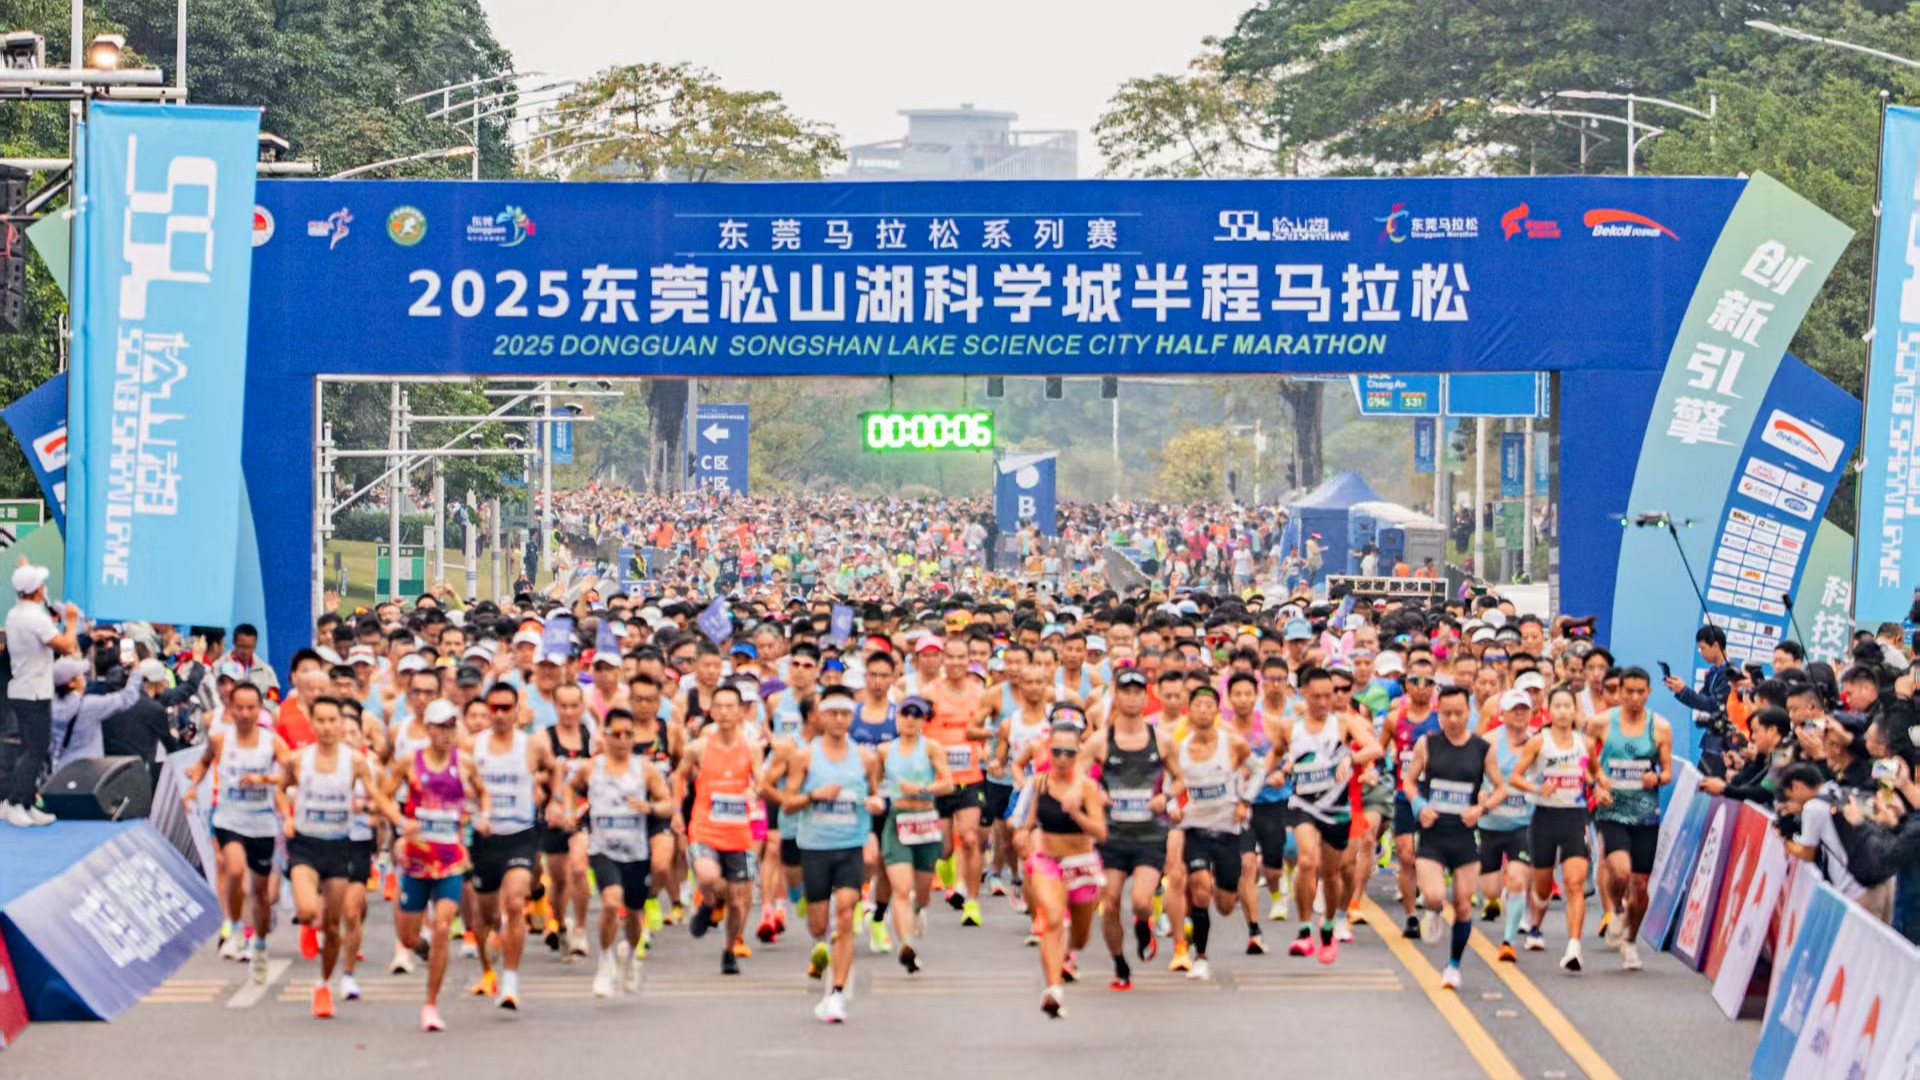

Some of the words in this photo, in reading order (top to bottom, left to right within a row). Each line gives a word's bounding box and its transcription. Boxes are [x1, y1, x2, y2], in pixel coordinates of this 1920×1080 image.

[719, 217, 1118, 250] 东莞马拉松系列赛
[1411, 217, 1478, 232] 东莞马拉松
[408, 262, 1471, 324] 2025东莞松山湖科学城半程马拉松
[493, 334, 555, 356] 2025
[560, 334, 718, 356] DONGGUAN
[729, 334, 884, 356] SONGSHAN
[887, 334, 956, 356] LAKE
[962, 334, 1082, 356] SCIENCE
[1088, 334, 1152, 355] CITY
[1155, 333, 1229, 355] HALF
[1232, 333, 1387, 355] MARATHON
[1667, 239, 1815, 446] 创新引擎
[868, 414, 991, 448] 00:00:06
[701, 455, 729, 471] C区
[1018, 495, 1036, 518] B
